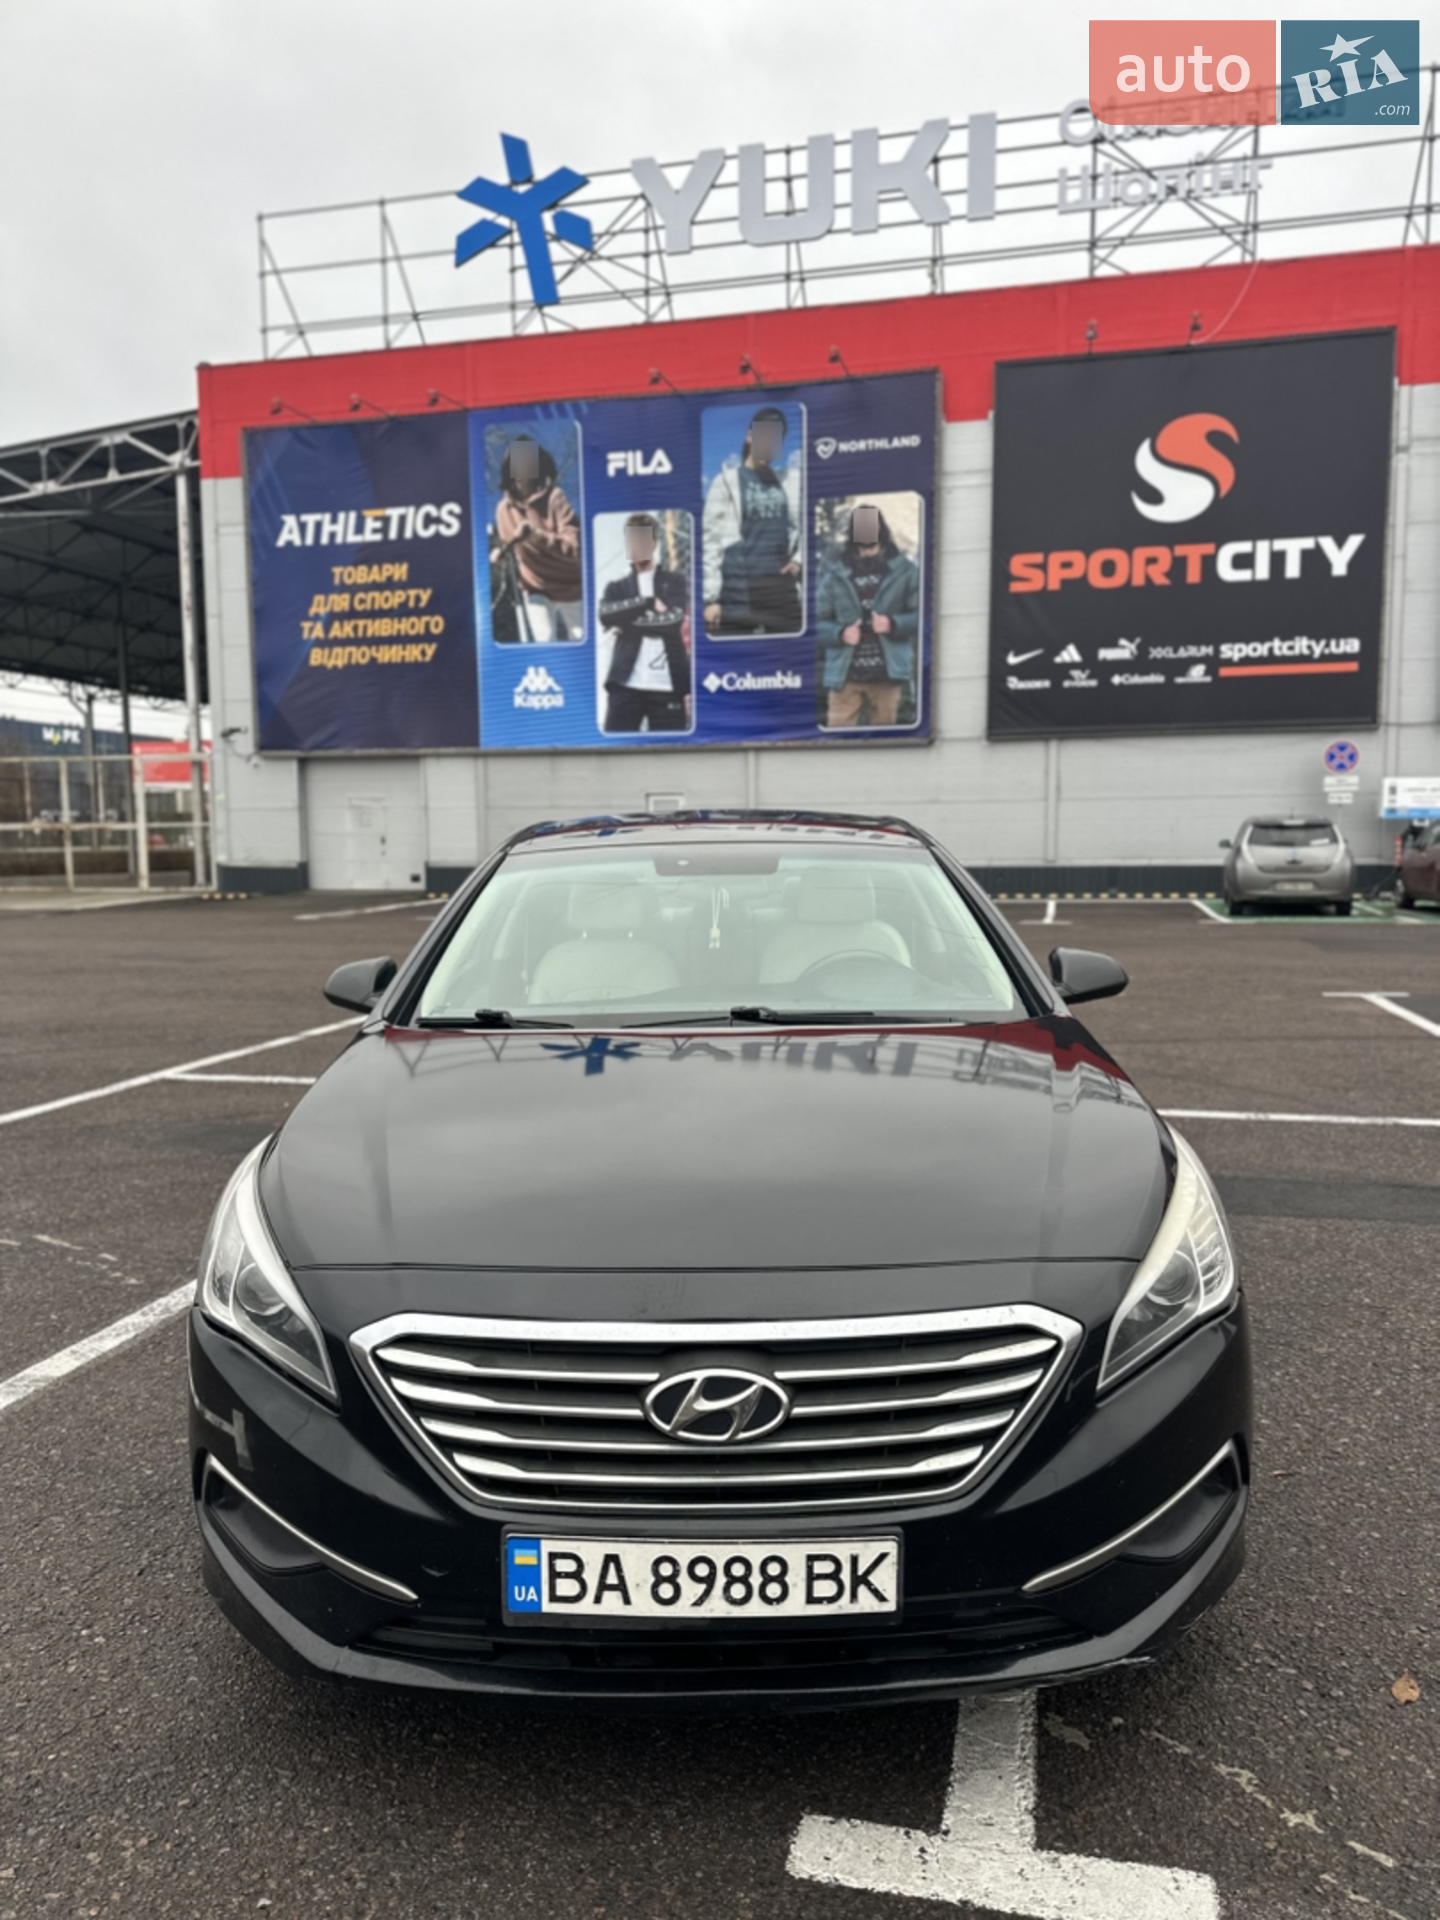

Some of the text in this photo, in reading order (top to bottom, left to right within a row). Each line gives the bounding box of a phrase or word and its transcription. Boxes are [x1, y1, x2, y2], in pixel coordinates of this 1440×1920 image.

[630, 110, 998, 257] YUKI
[837, 434, 922, 454] NORTHLAND
[606, 447, 673, 478] FILA
[275, 502, 463, 548] ATHLETICS
[331, 561, 409, 586] ТОВАРИ
[1008, 533, 1367, 593] SPORTCITY
[308, 588, 432, 618] ДЛЯ СПОРТУ
[299, 614, 445, 641] ТА АКТИВНОГО
[308, 642, 438, 670] ВІДПОЧИНКУ
[1218, 635, 1361, 662] sportcity.ua
[721, 669, 803, 692] Columbia
[513, 693, 565, 711] Kappa
[547, 1551, 892, 1607] BA 8988 BK
[513, 1585, 539, 1603] UA
